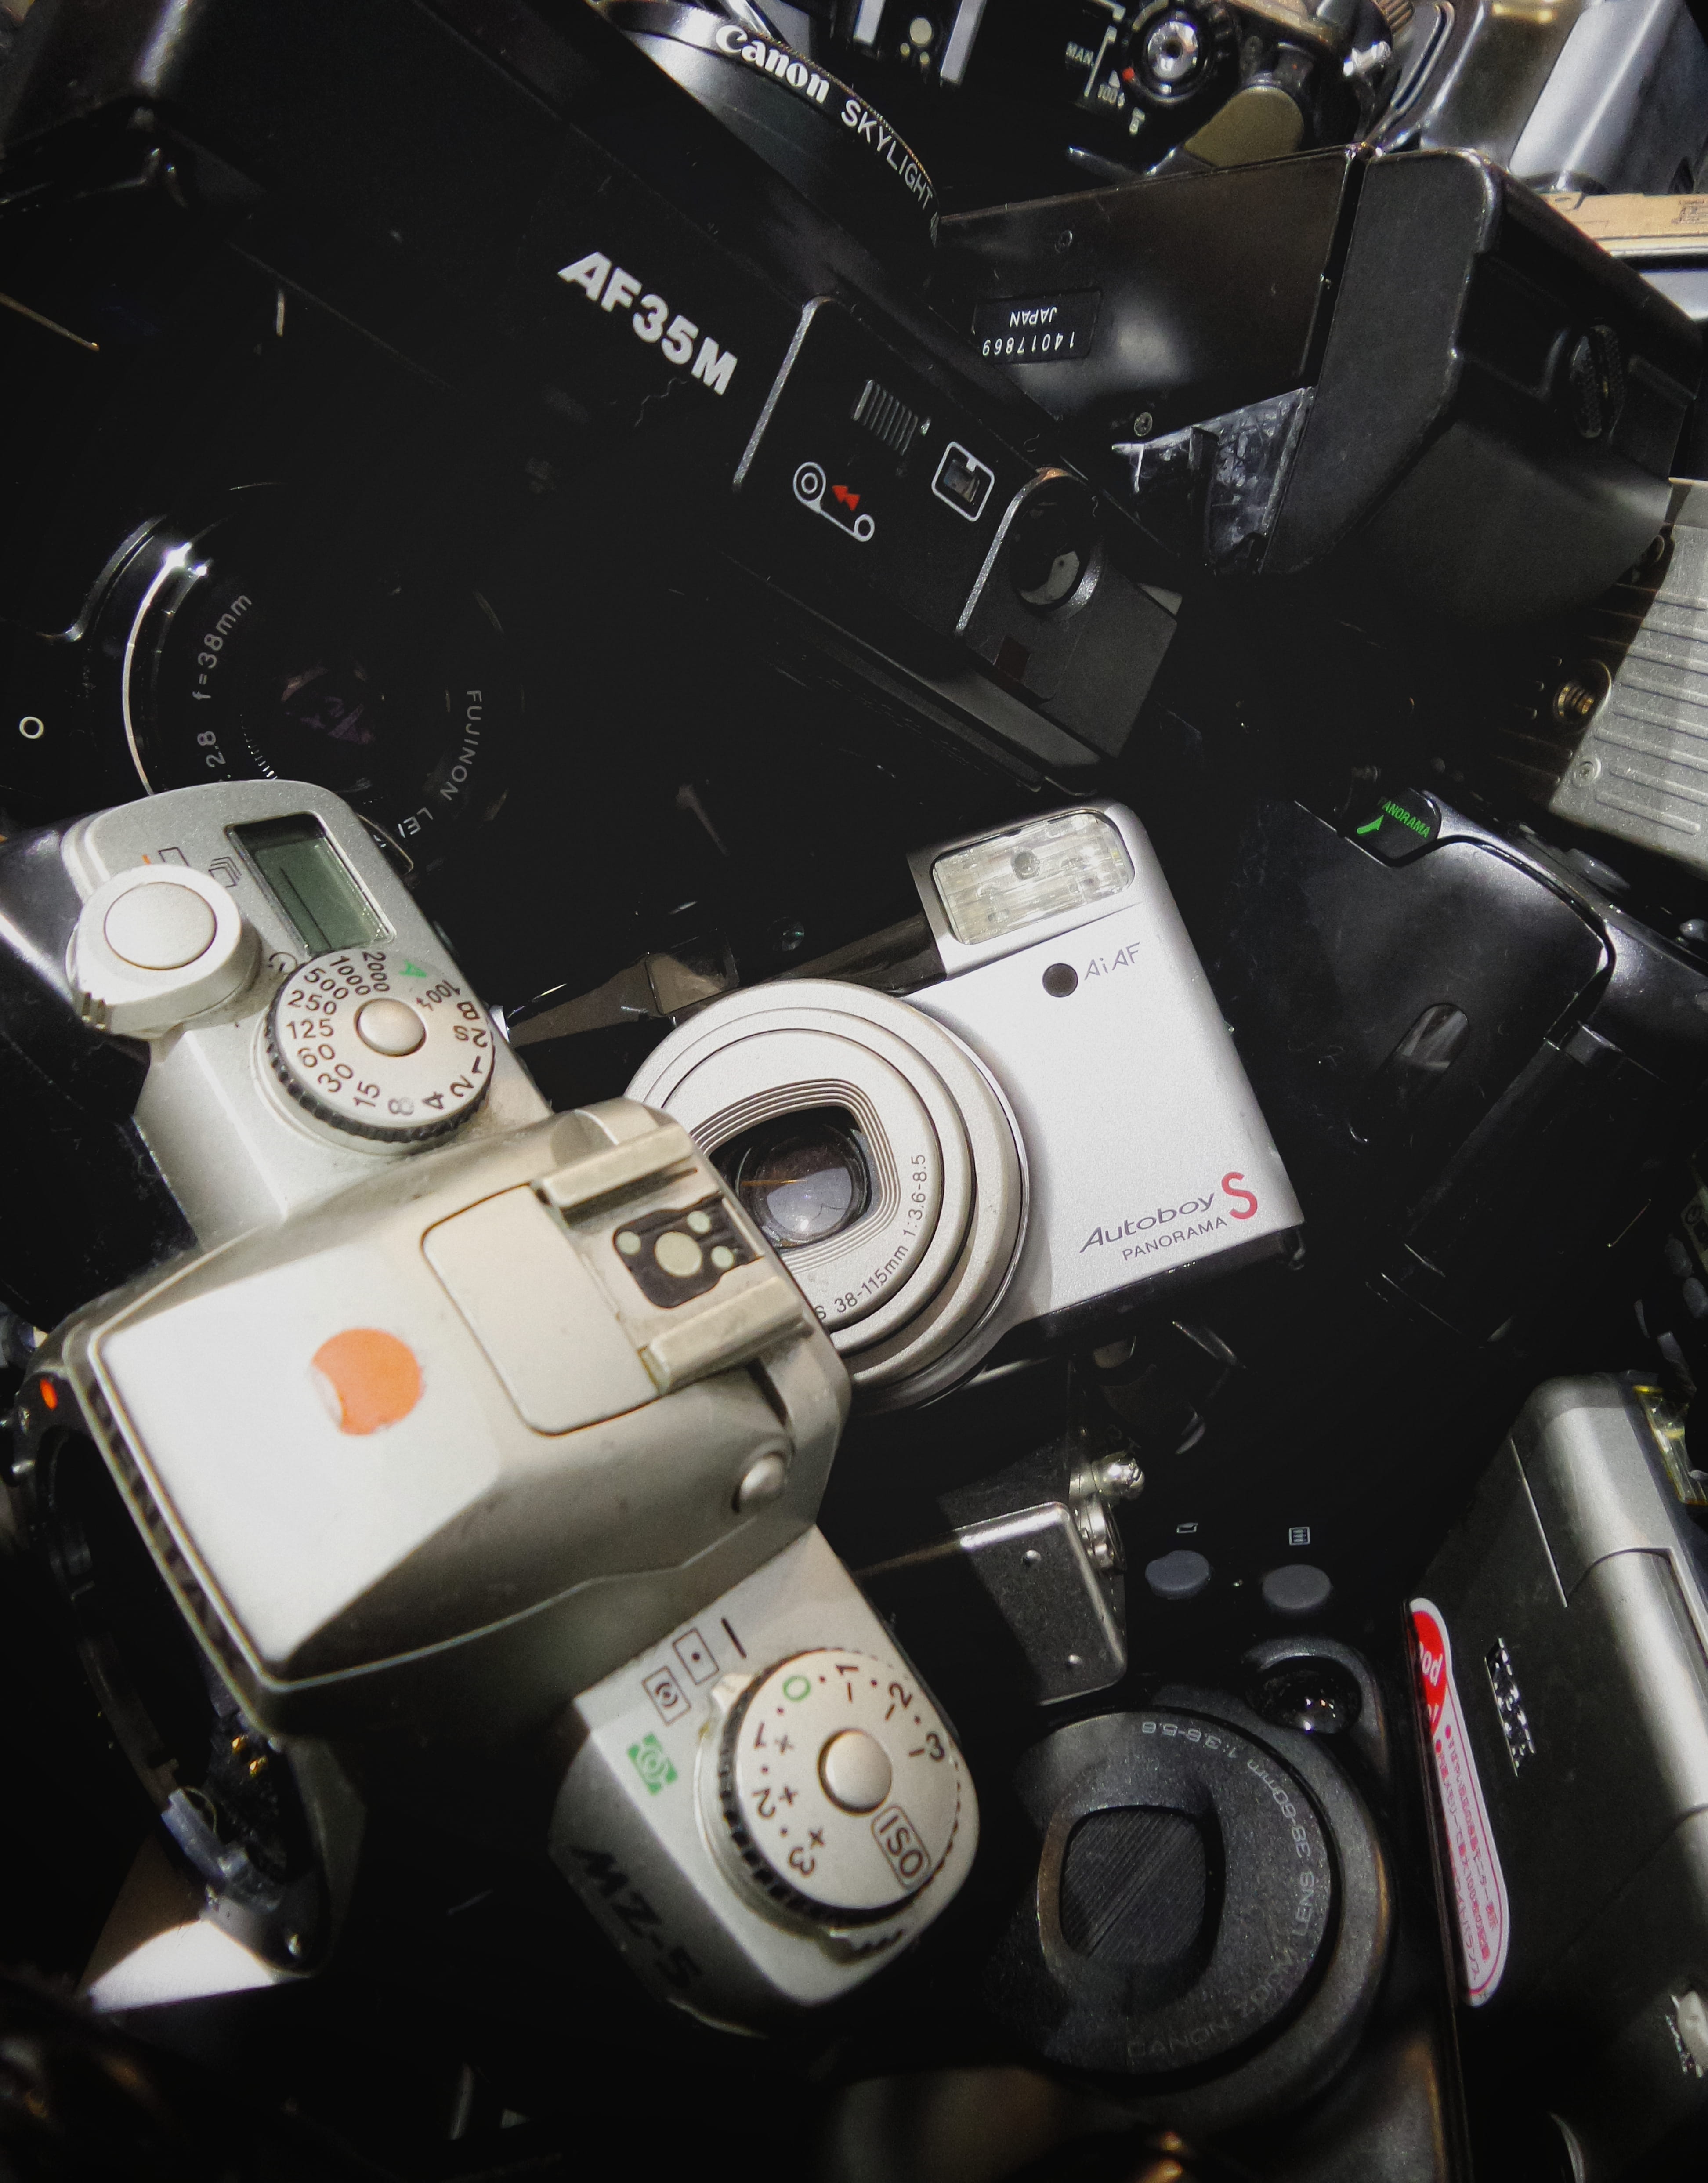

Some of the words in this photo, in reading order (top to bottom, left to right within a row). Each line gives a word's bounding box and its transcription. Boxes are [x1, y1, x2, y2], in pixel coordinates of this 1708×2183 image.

[716, 24, 830, 104] Canon
[841, 99, 934, 210] SKYLIGHT
[557, 251, 738, 395] AF35M
[1009, 306, 1057, 328] JAPAN
[982, 331, 1075, 357] 14017869
[439, 690, 483, 801] FUJINON
[329, 955, 371, 996] 1000
[362, 951, 390, 992] 2000
[398, 959, 428, 979] A
[304, 967, 349, 1000] 500
[287, 989, 337, 1016] 250
[456, 1000, 481, 1021] B
[286, 1018, 334, 1040] 125
[297, 1043, 336, 1068] 60
[471, 1055, 483, 1075] 1
[317, 1063, 355, 1093] 30
[449, 1075, 475, 1097] 2
[353, 1081, 381, 1108] 15
[387, 1097, 416, 1116] 8
[422, 1090, 445, 1110] 4
[1079, 1192, 1216, 1253] Autoboy
[1221, 1171, 1259, 1220] S
[834, 1244, 909, 1313] 38-115mm
[903, 1154, 928, 1237] 1:3.6-8.5
[1122, 1215, 1228, 1262] PANORAMA
[879, 1814, 924, 1879] ISO
